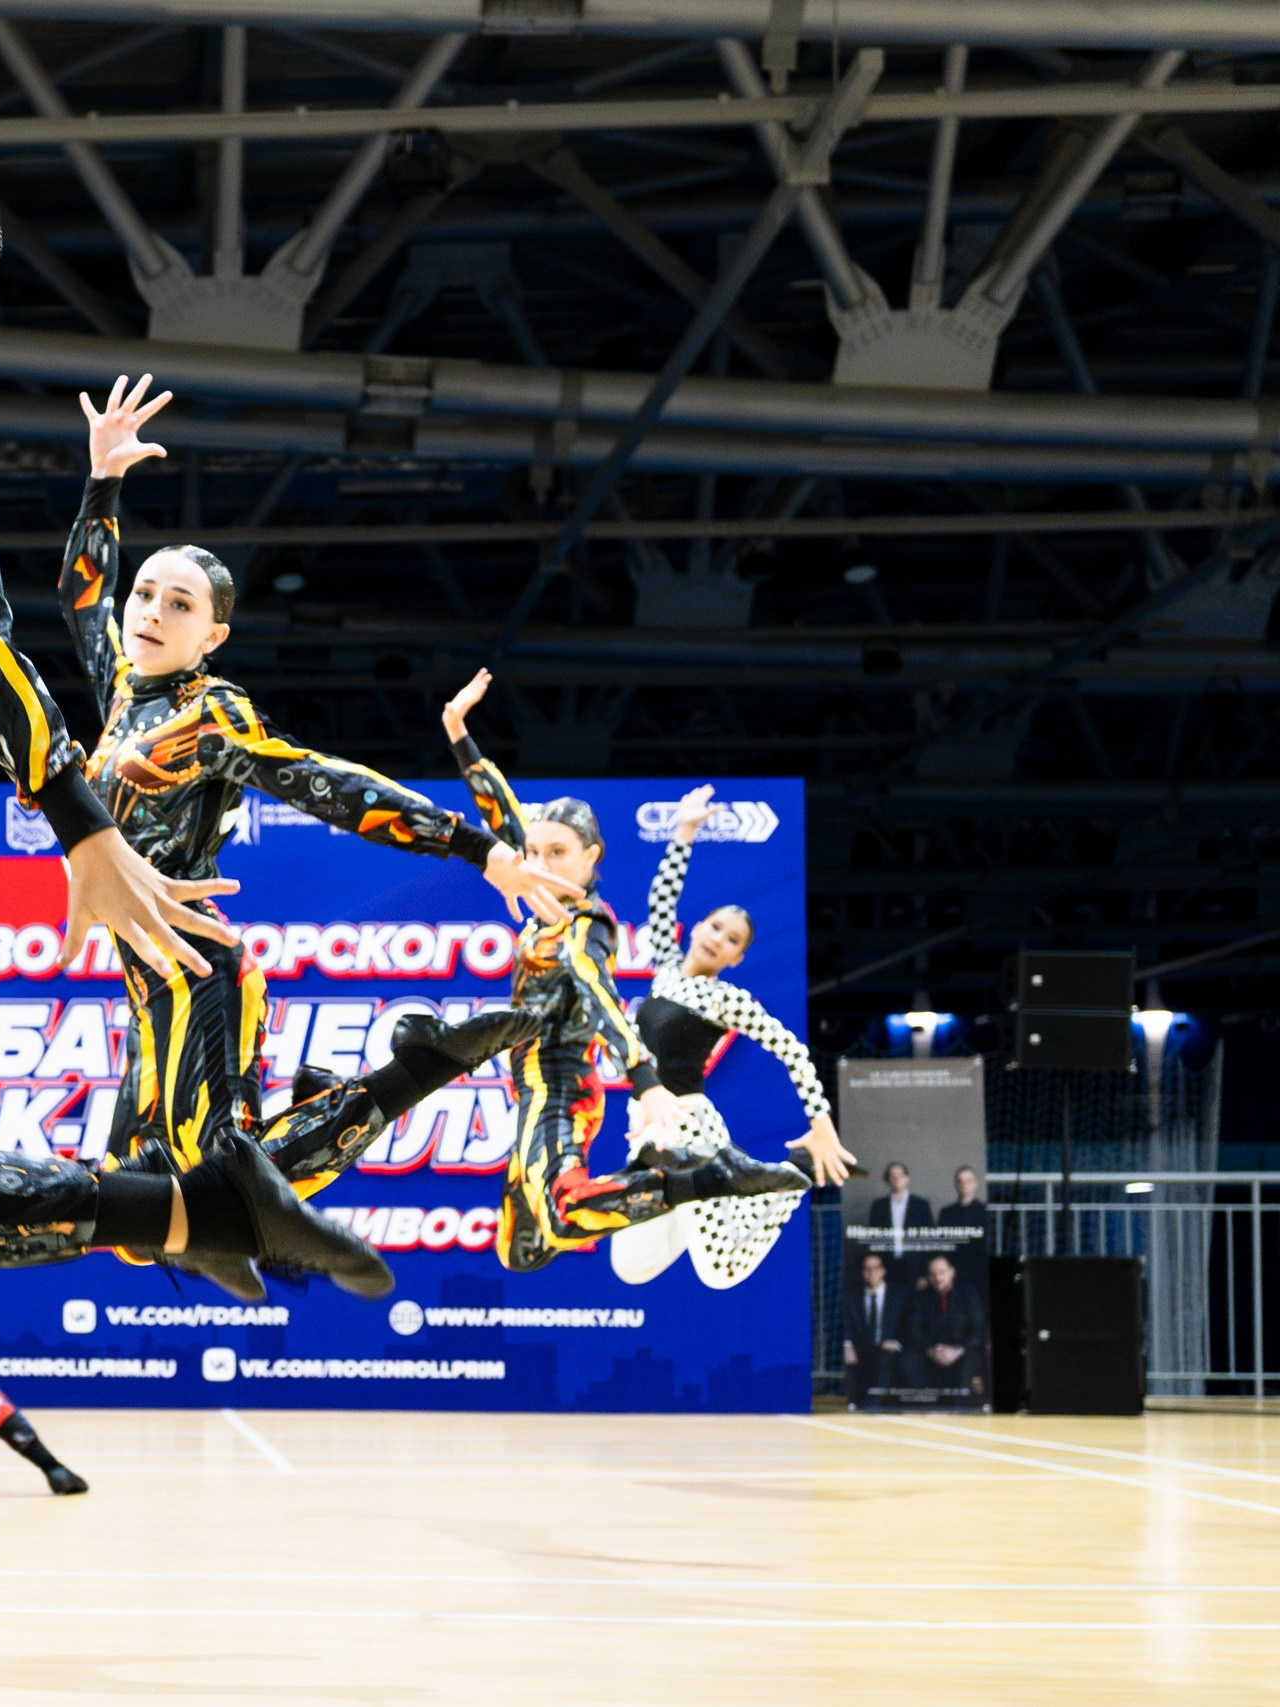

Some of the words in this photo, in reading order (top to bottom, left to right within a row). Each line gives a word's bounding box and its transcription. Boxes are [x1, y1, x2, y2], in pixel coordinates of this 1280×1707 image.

[105, 1304, 290, 1327] VK.COM/FDSARR
[424, 1308, 645, 1328] WWW.PRIMORSKY.RU
[239, 1359, 506, 1380] VK.COM/ROCKNROLLPRIM
